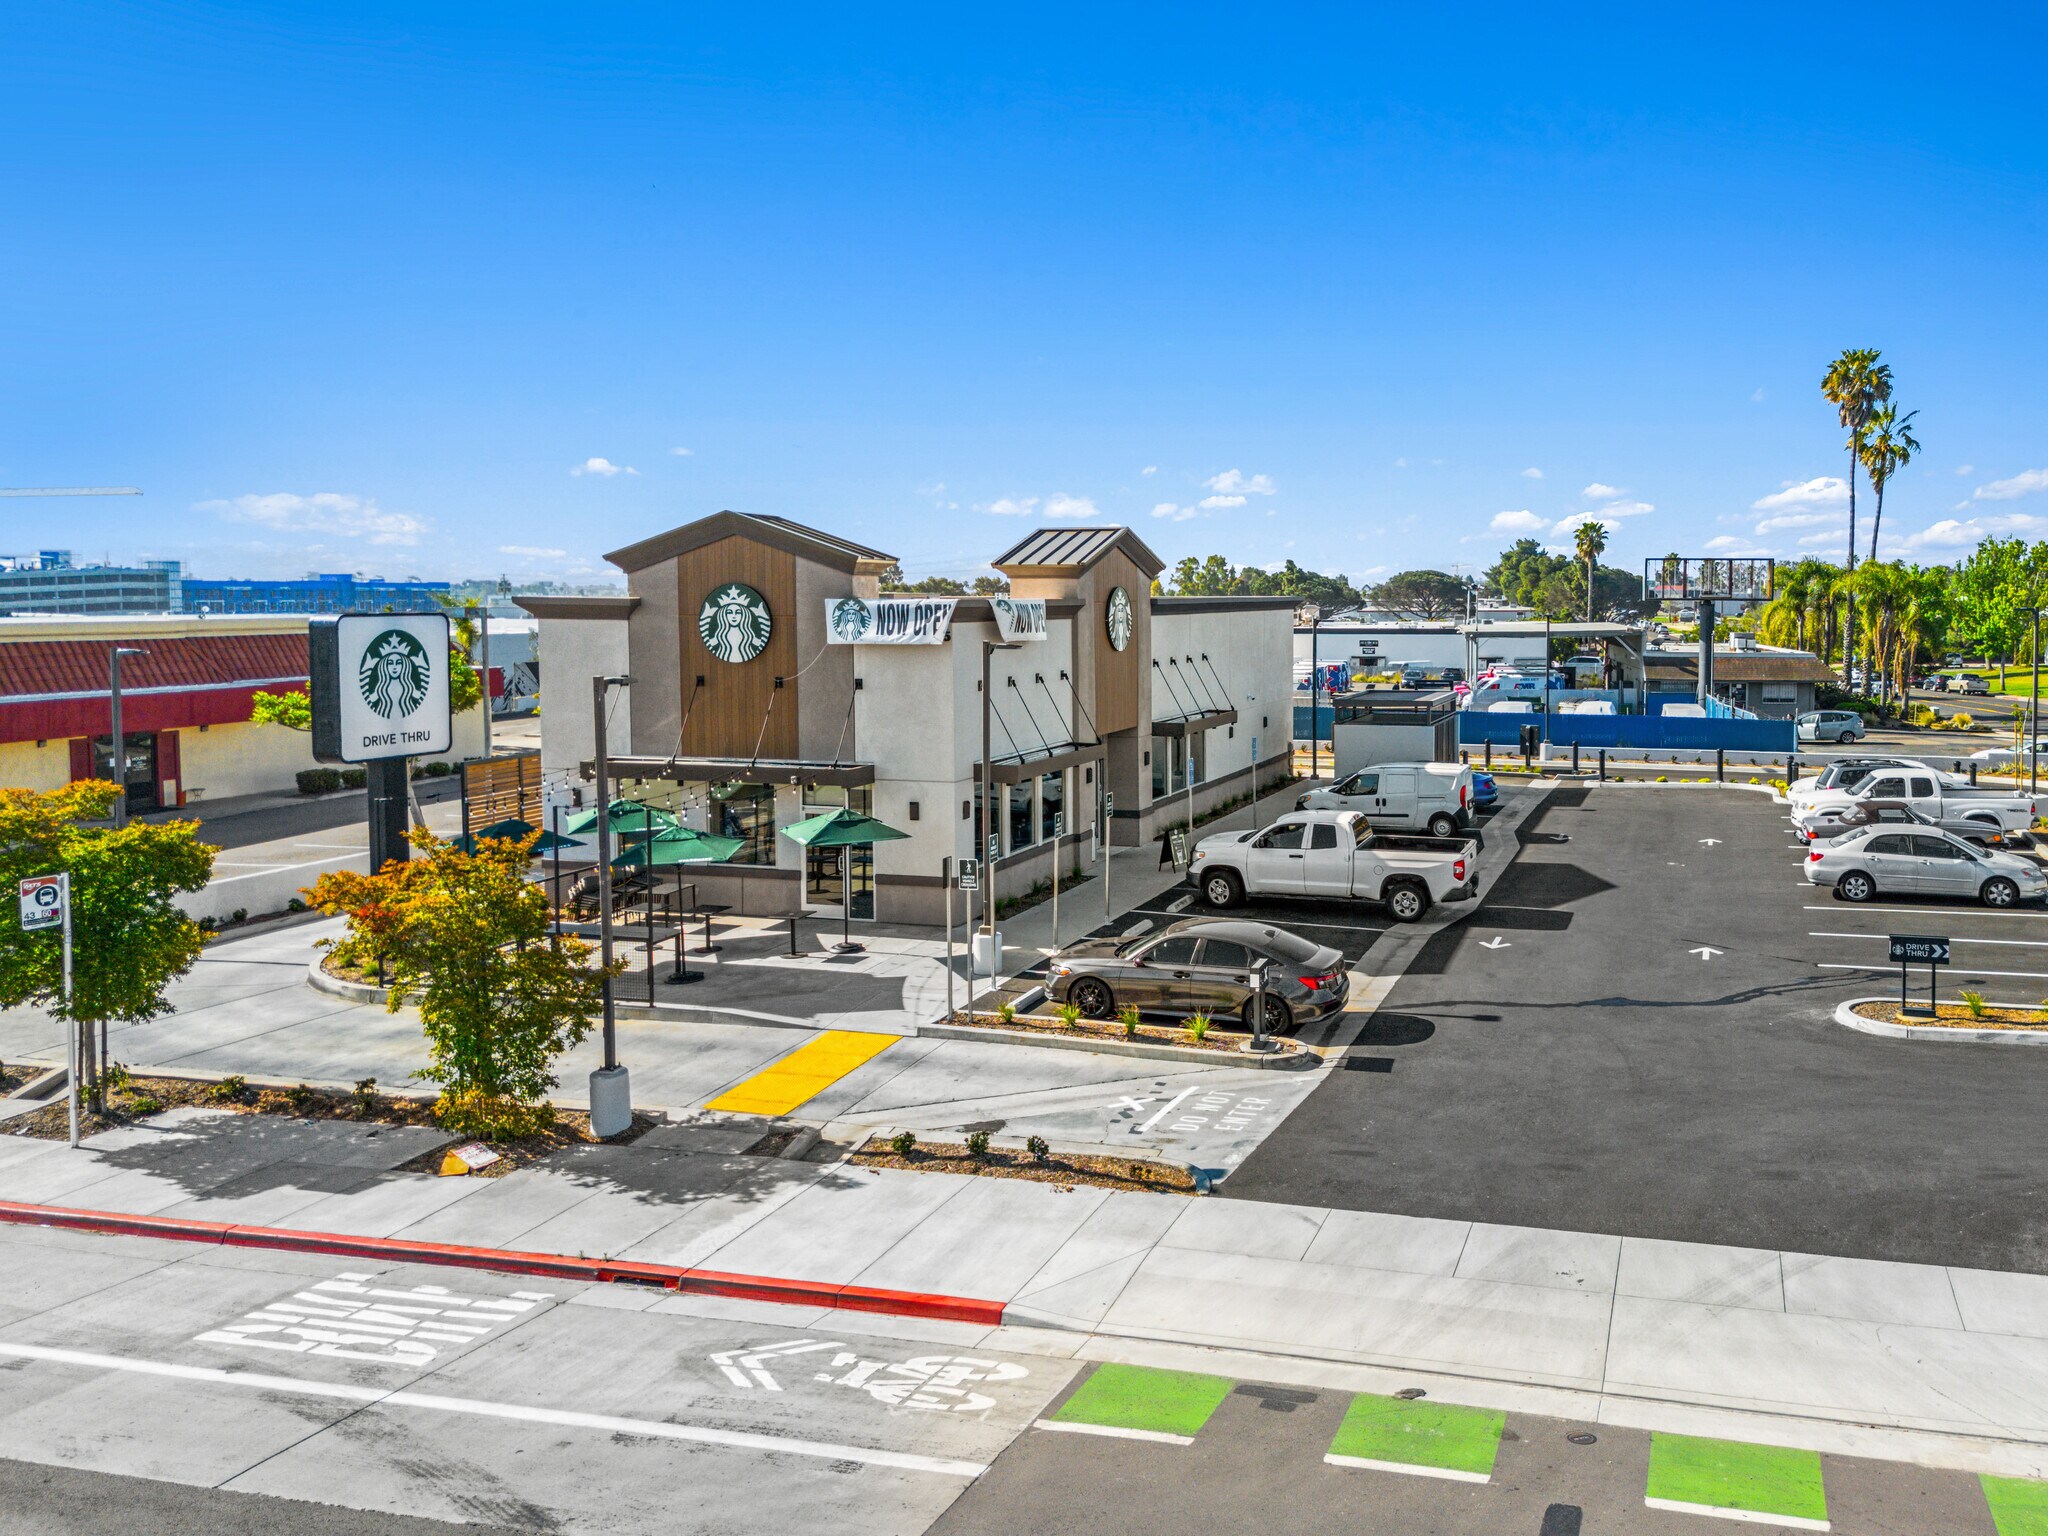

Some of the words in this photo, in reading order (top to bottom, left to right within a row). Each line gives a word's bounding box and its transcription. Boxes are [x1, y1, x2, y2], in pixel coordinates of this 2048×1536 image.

[876, 603, 909, 636] NOW
[914, 603, 951, 636] OPE
[1014, 603, 1032, 633] NOW
[1030, 603, 1045, 633] OPE
[363, 733, 396, 747] DRIVE
[401, 730, 431, 743] THRU
[24, 911, 36, 919] 43
[42, 909, 52, 917] 60
[1905, 943, 1930, 951] DRIVE
[1906, 949, 1929, 957] THRU
[1169, 1115, 1209, 1132] DO
[1192, 1090, 1237, 1112] NOT
[1213, 1097, 1272, 1131] ENTER
[193, 1272, 556, 1367] BIKE
